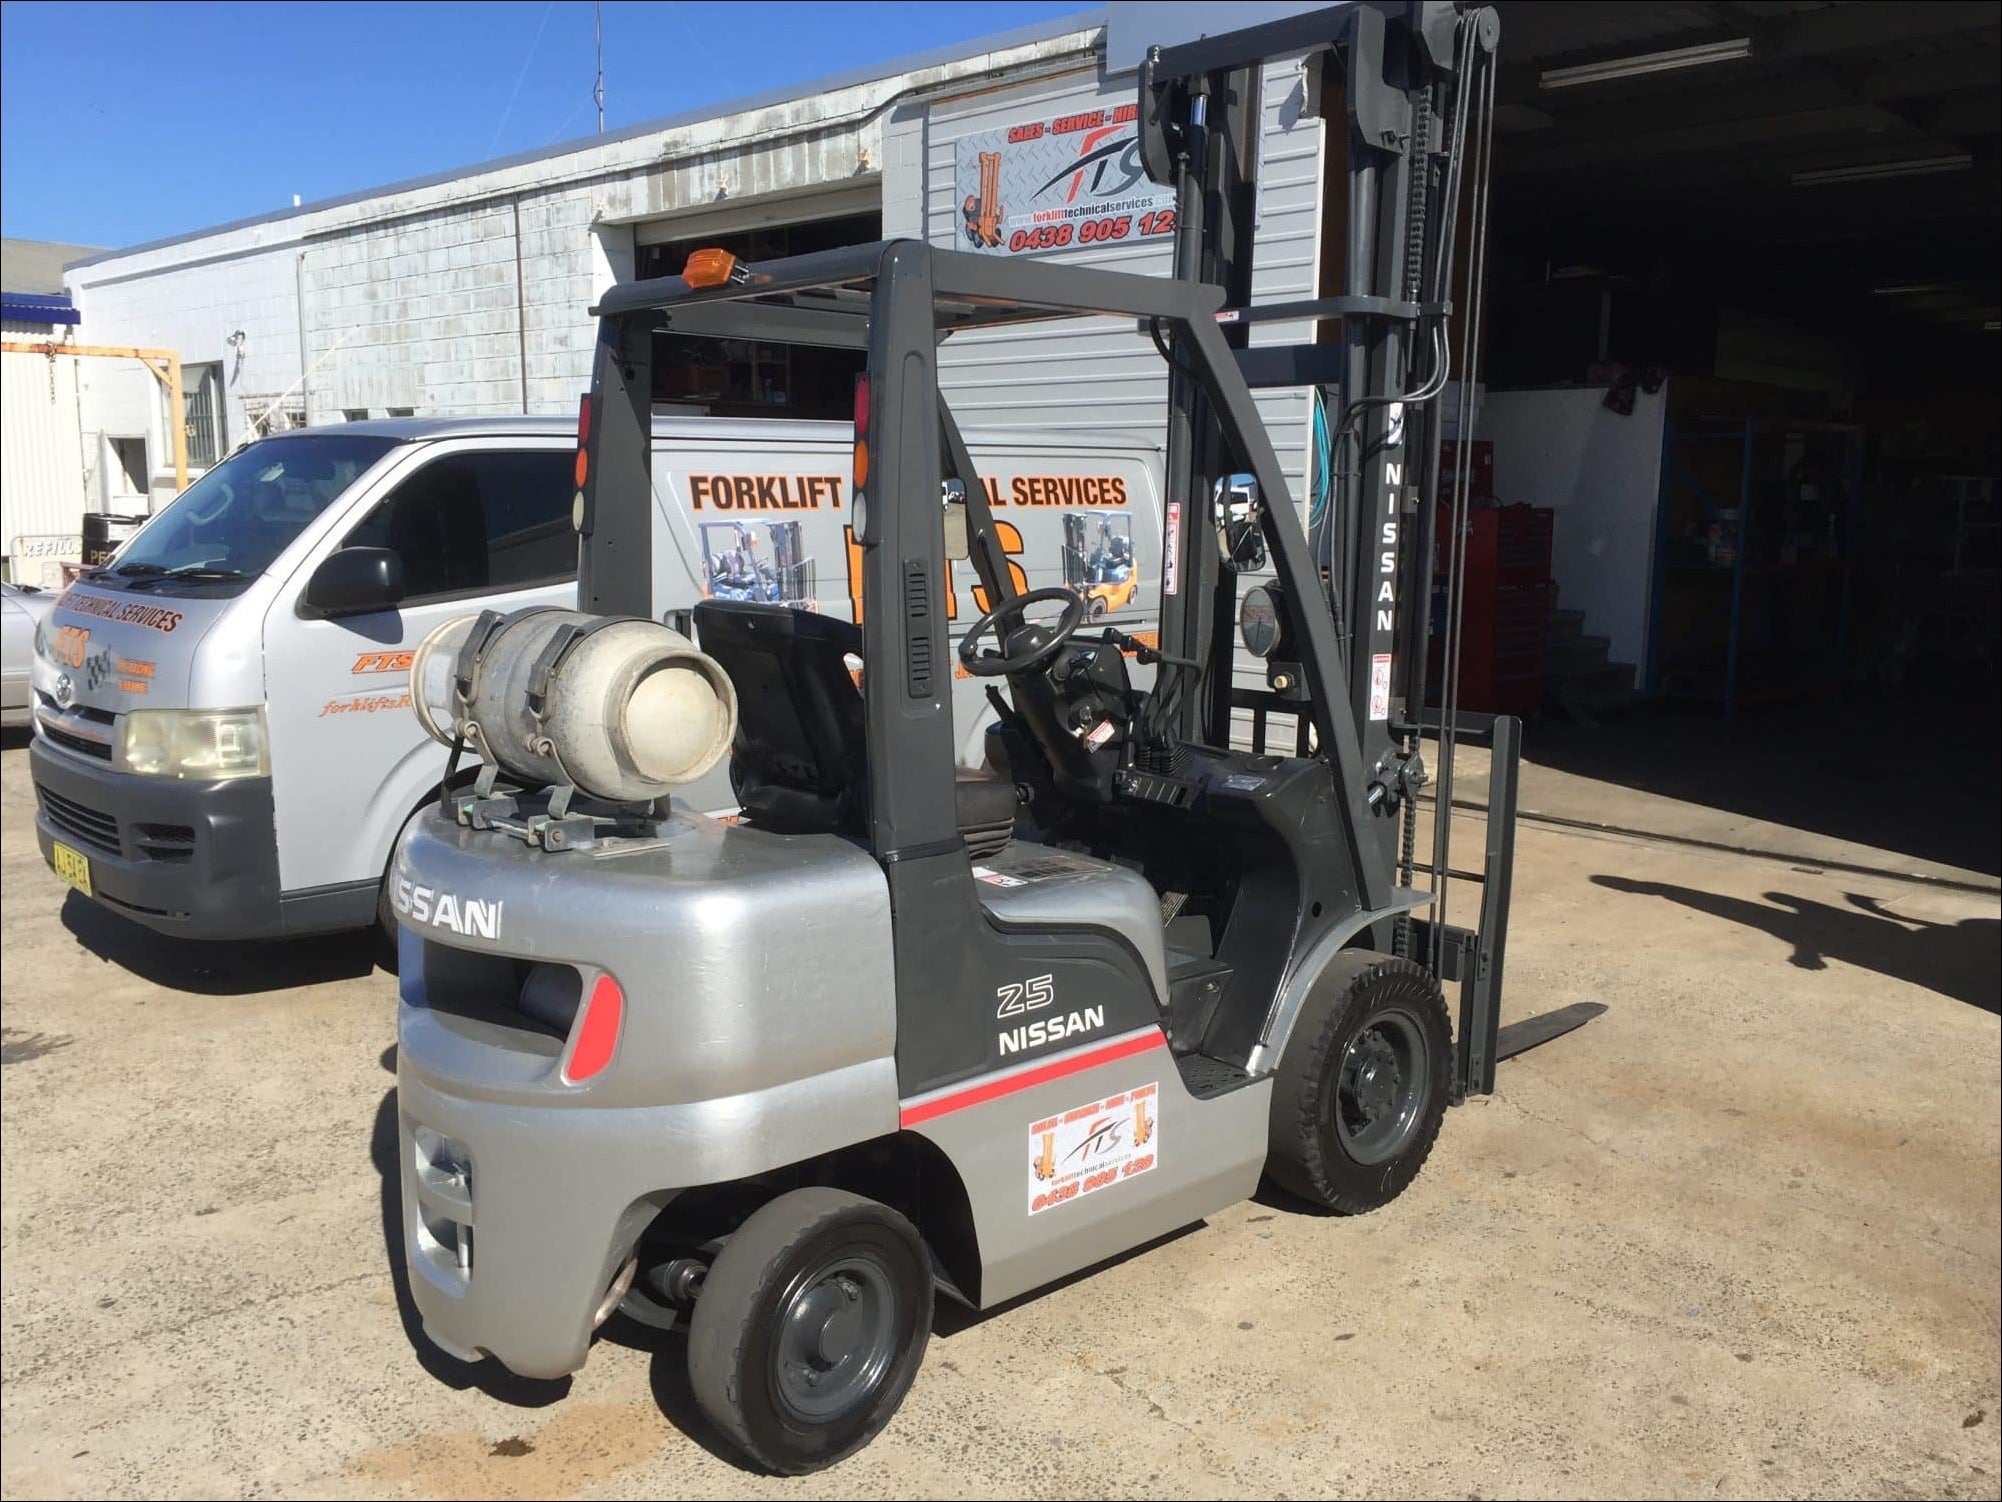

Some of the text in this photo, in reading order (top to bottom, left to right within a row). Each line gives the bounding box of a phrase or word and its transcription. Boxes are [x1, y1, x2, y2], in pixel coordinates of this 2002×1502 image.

[1008, 122, 1044, 144] SALES
[1052, 110, 1105, 135] SERVICE
[1112, 103, 1138, 124] HIR
[1010, 209, 1177, 252] 0438 905 12
[688, 475, 842, 510] FORKLIFT
[1011, 475, 1127, 507] SERVICES
[1377, 463, 1402, 631] NISSAN
[117, 603, 183, 633] SERVICES
[54, 624, 91, 669] FTS
[394, 878, 503, 940] SSAN
[997, 973, 1054, 1019] 25
[998, 1004, 1104, 1056] NISSAN
